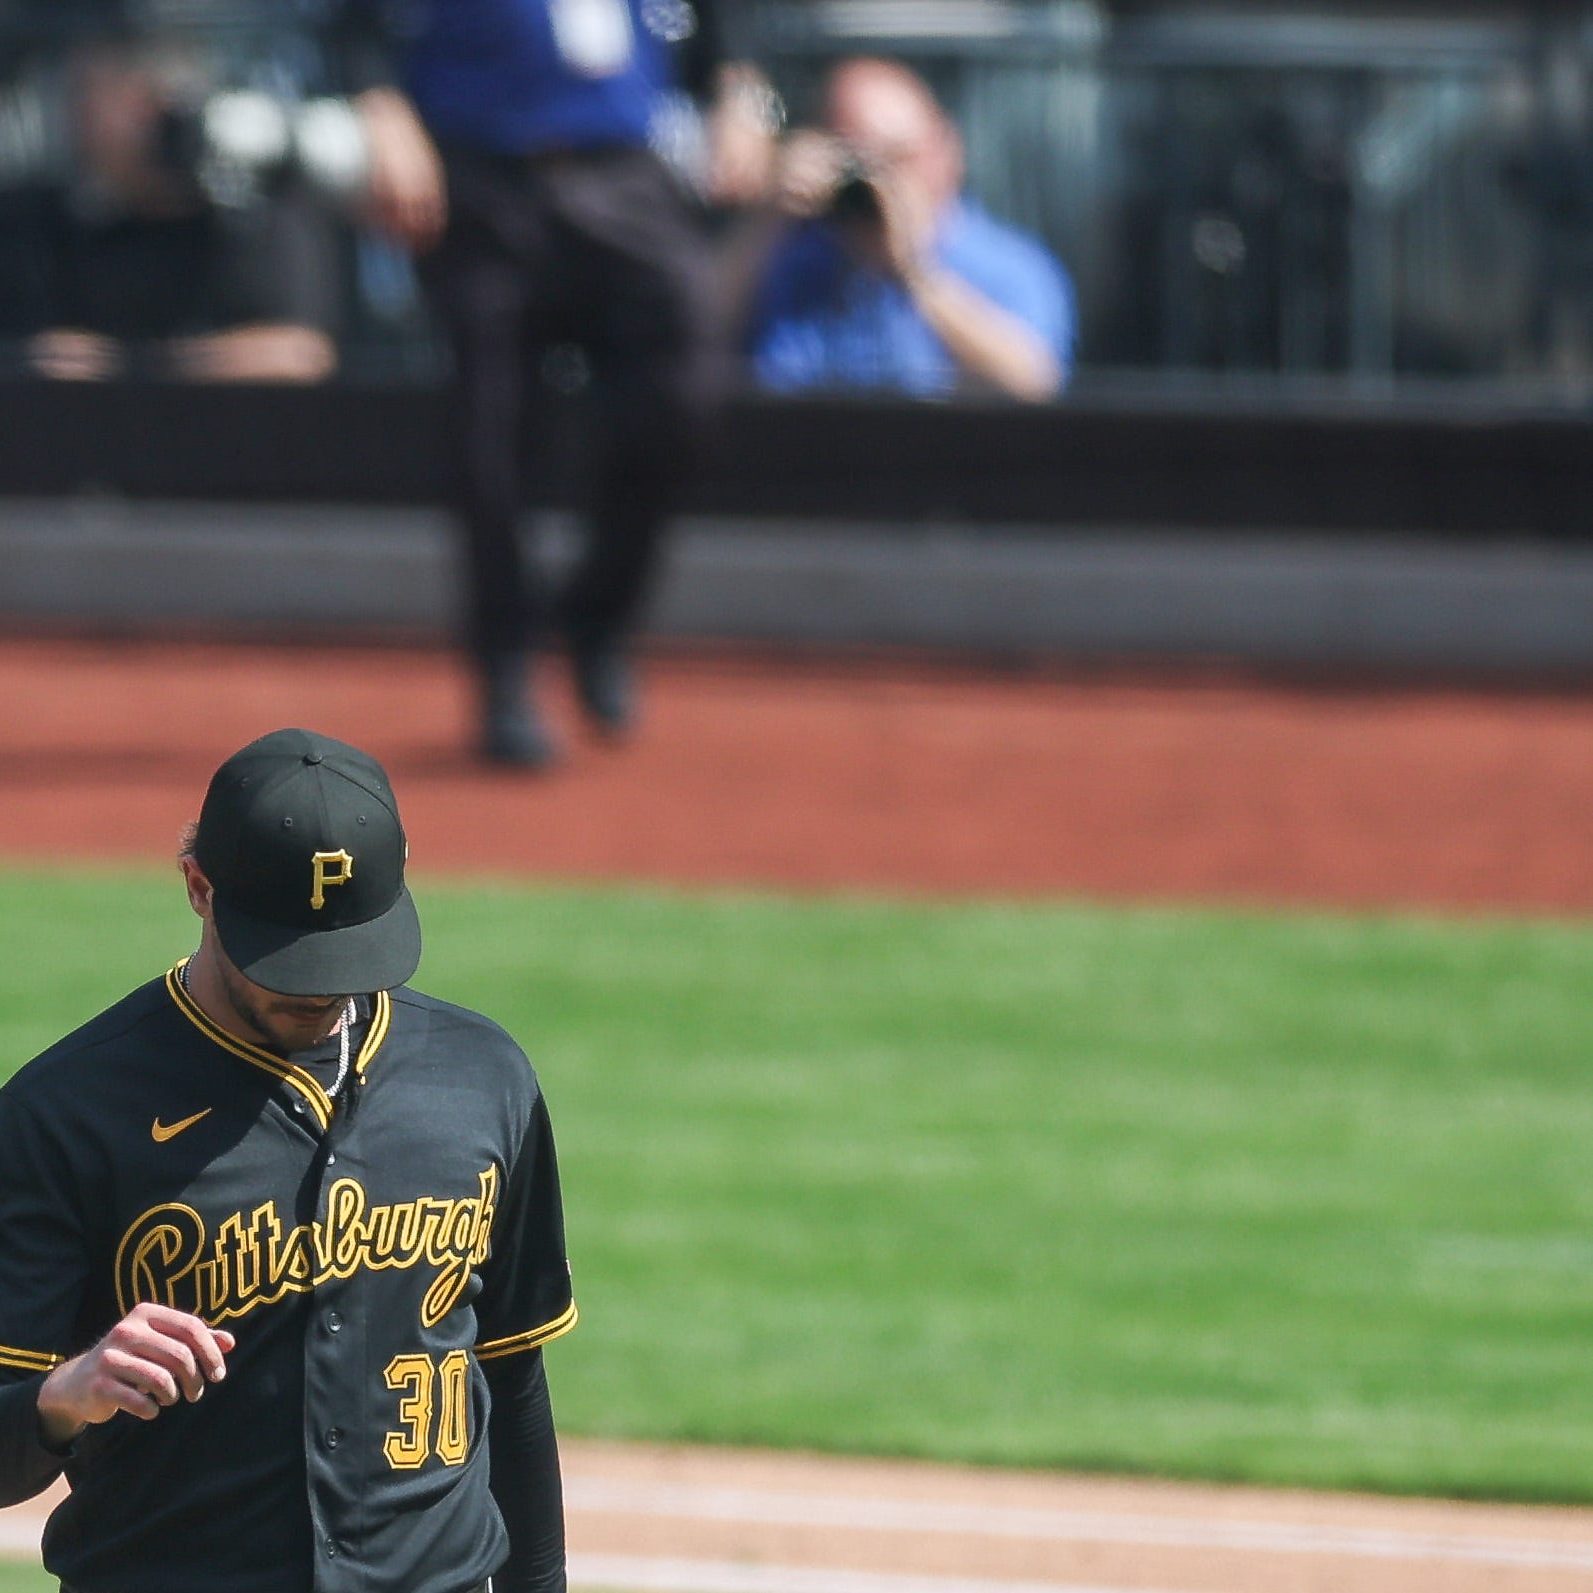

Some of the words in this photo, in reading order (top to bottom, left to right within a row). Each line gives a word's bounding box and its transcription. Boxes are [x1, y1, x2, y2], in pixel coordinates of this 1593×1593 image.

[310, 848, 354, 910] P
[115, 1162, 498, 1328] Pittsburgh
[383, 1349, 470, 1469] 30
